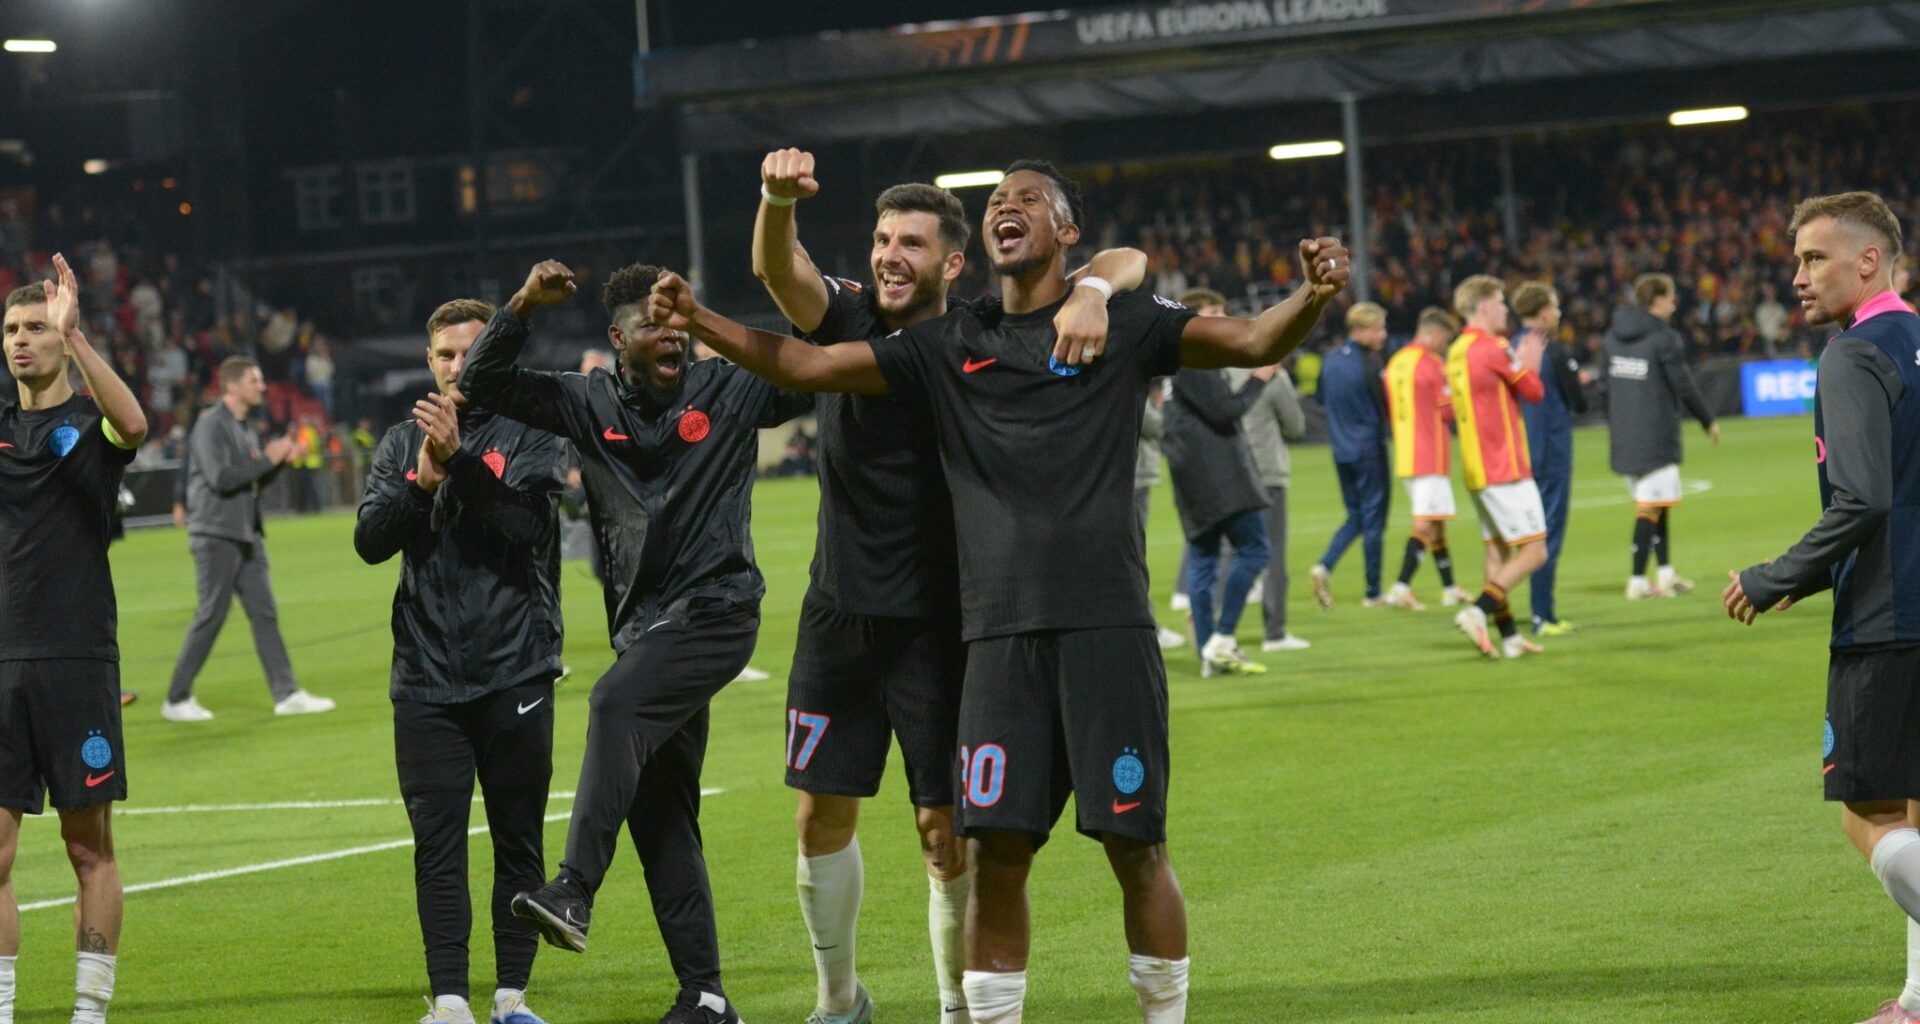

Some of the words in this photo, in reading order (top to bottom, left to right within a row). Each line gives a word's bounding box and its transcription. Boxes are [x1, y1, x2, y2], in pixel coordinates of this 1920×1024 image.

[1076, 12, 1154, 44] UEFA
[1154, 2, 1273, 37] EUROPA
[1273, 0, 1389, 25] LEAGUE
[786, 708, 830, 771] 17
